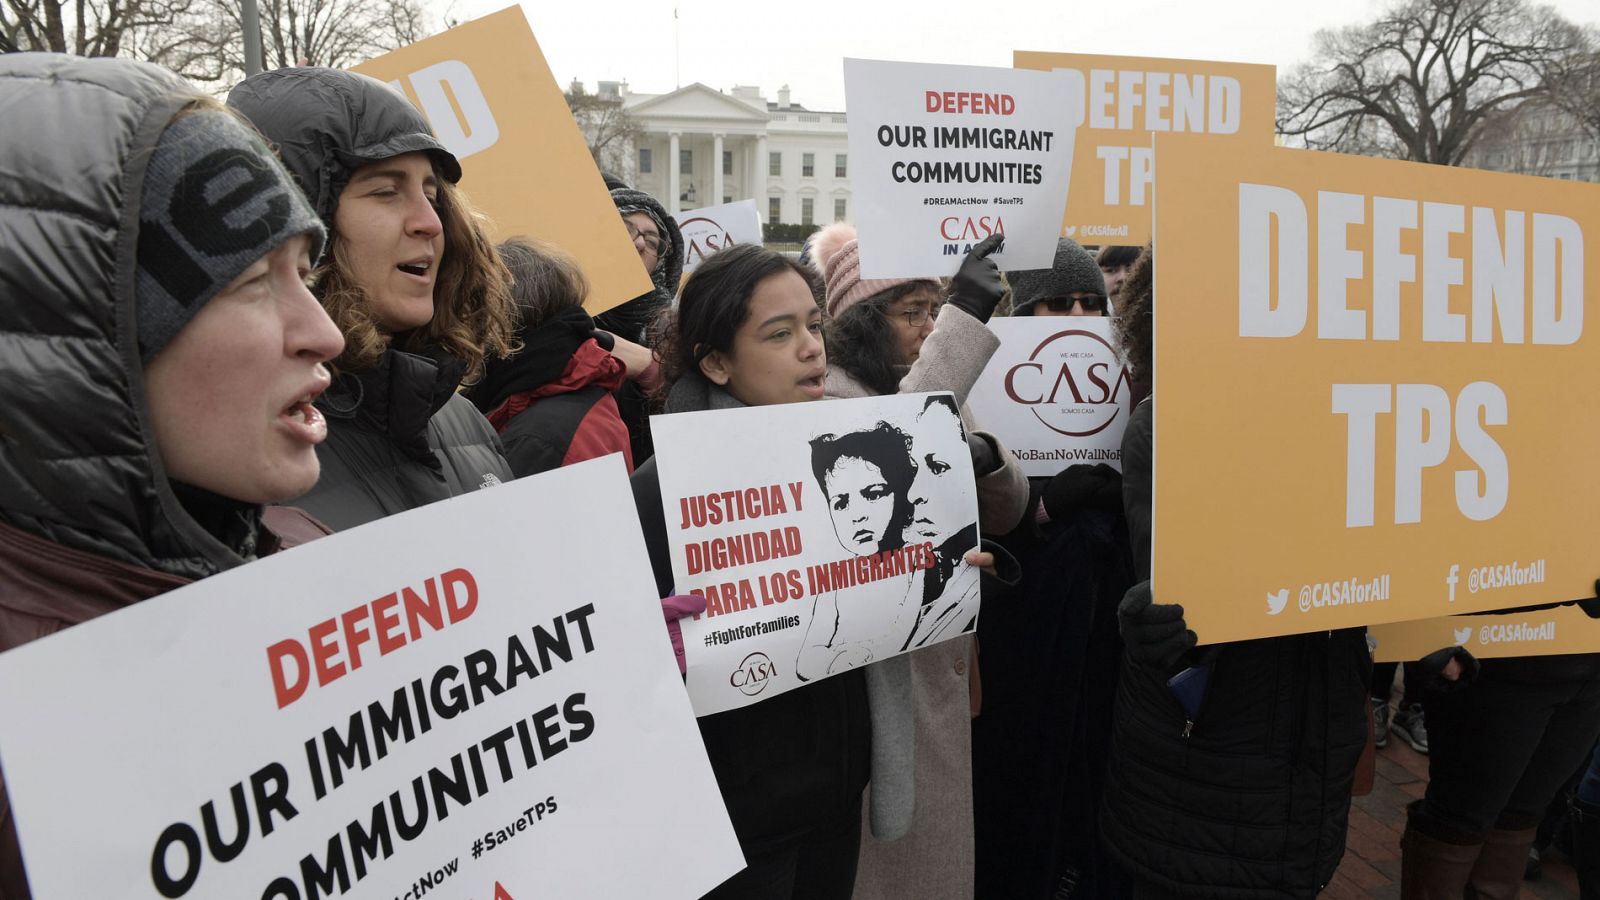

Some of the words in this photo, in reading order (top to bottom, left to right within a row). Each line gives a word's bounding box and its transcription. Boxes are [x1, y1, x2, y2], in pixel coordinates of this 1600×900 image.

[925, 91, 1015, 116] DEFEND
[877, 124, 927, 148] OUR
[933, 126, 1053, 152] IMMIGRANT
[892, 161, 1042, 184] COMMUNITIES
[1097, 145, 1152, 206] TP
[923, 197, 988, 205] #DREAMActNow
[993, 197, 1023, 205] #SaveTPS
[940, 216, 1005, 240] CASA
[1081, 224, 1128, 237] @CASAforAll
[943, 244, 958, 255] IN
[1239, 182, 1584, 346] DEFEND
[1004, 362, 1132, 405] CASA
[1332, 381, 1508, 528] TPS
[680, 483, 787, 529] JUSTICIA
[788, 481, 803, 512] Y
[684, 526, 803, 576] DIGNIDAD
[758, 569, 804, 606] LOS
[806, 541, 936, 596] INMIGRANTES
[1468, 559, 1545, 594] @CASAforAll
[1299, 574, 1390, 613] @CASAforAll
[266, 568, 479, 710] DEFEND
[704, 615, 800, 648] #FightForFamilies
[1479, 621, 1555, 645] @CASAforAll
[730, 661, 777, 687] CASA
[150, 762, 299, 899] OUR
[304, 602, 596, 801] IMMIGRANT
[260, 692, 596, 900] MMUNITIES
[471, 795, 558, 859] #SaveTPS
